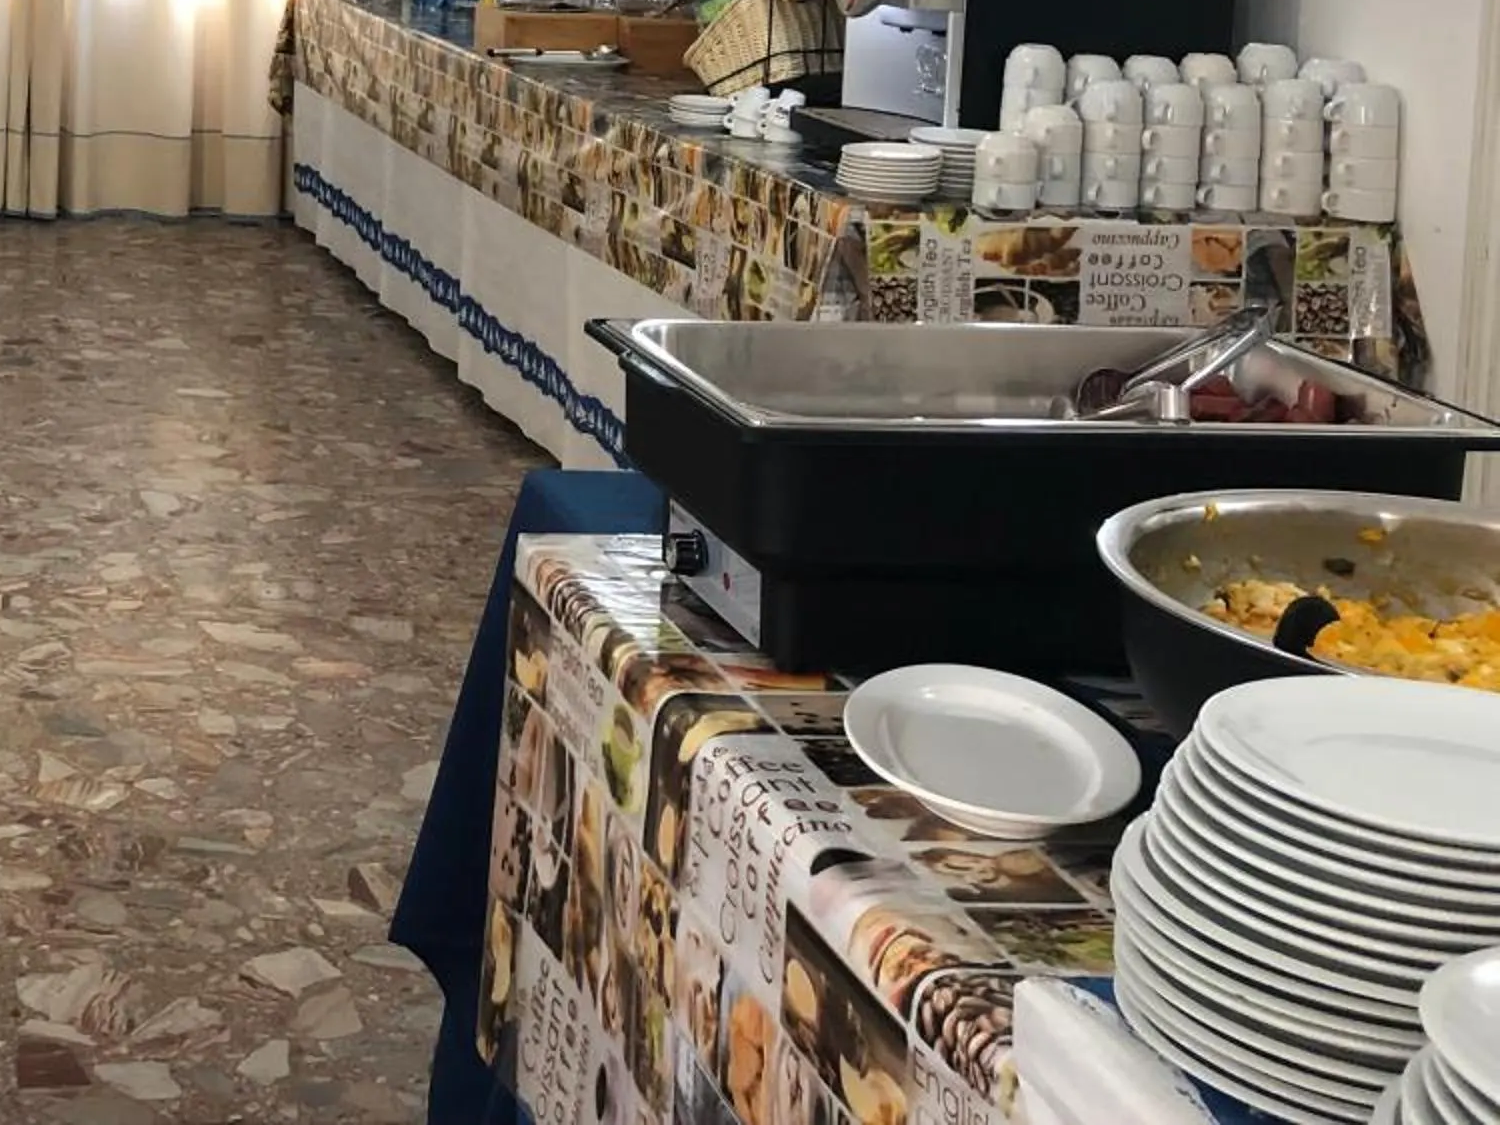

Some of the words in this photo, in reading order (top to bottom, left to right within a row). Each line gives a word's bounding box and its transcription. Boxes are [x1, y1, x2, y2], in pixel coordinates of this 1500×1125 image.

[921, 273, 938, 322] nglish
[1085, 293, 1147, 312] Coffee
[1087, 253, 1163, 270] Coffee
[1090, 273, 1184, 292] Croissant
[707, 755, 804, 839] Coffee
[719, 776, 817, 945] Croissant
[742, 797, 843, 919] Coffee
[758, 816, 853, 984] Cappuccino
[536, 978, 564, 1125] oissant
[554, 998, 578, 1125] offee
